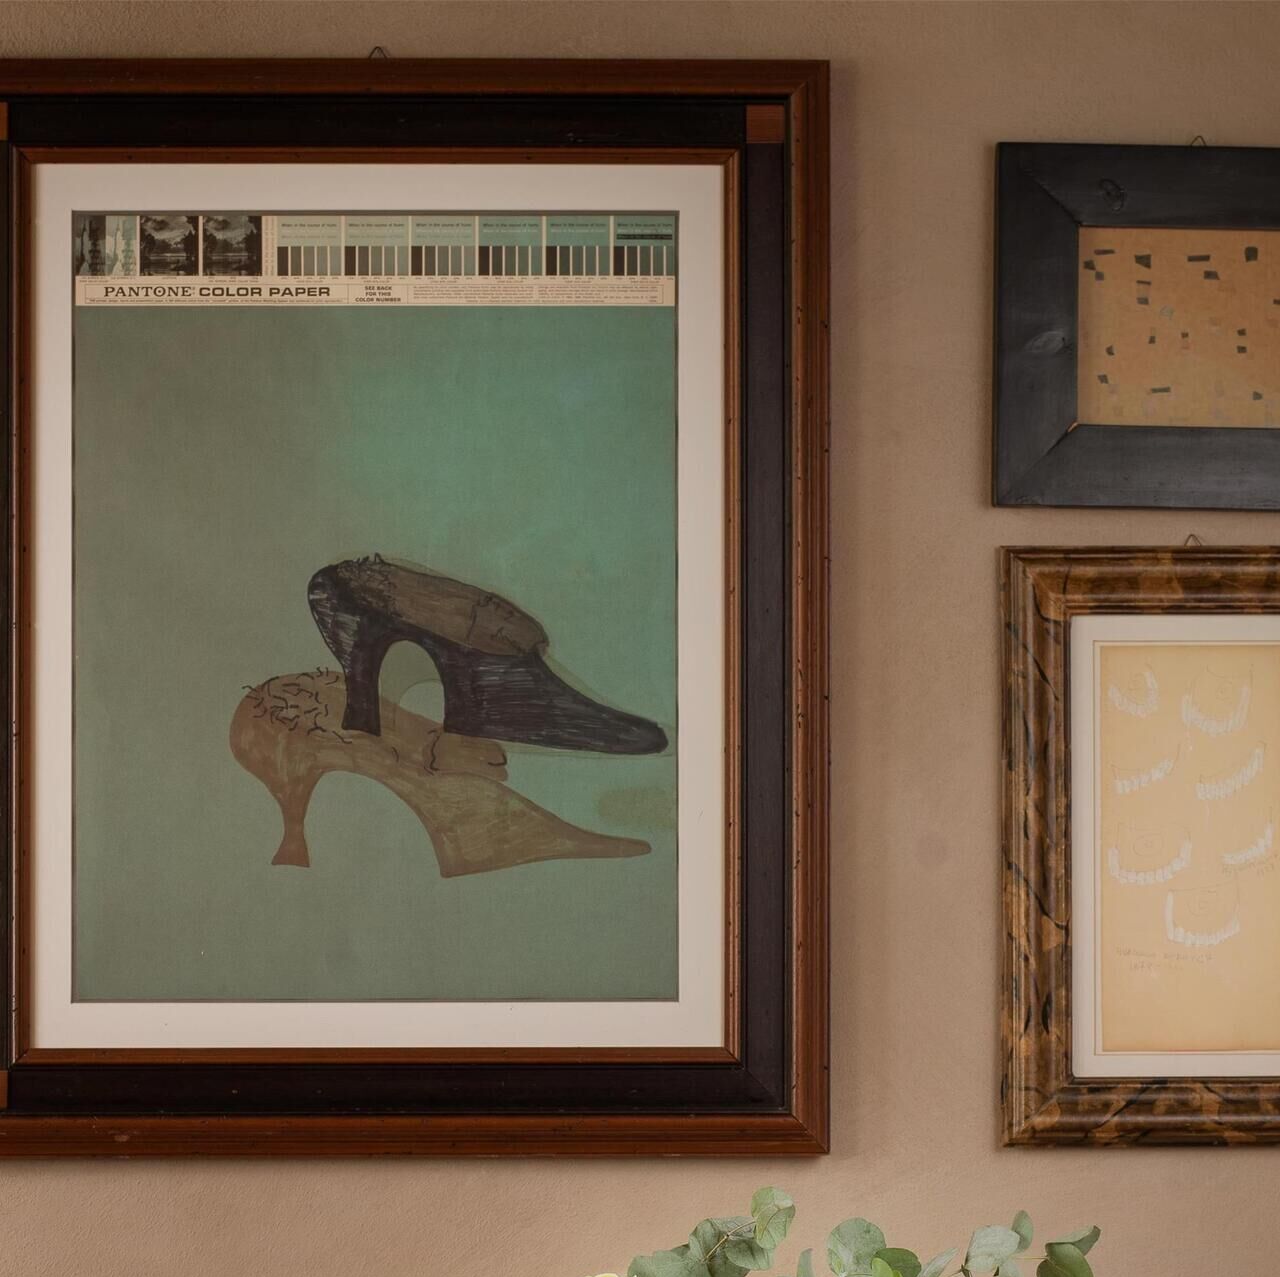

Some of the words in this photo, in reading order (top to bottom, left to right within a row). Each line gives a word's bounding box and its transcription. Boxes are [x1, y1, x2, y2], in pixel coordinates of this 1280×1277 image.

[104, 286, 192, 297] PANTONE
[199, 286, 262, 297] COLOR
[269, 286, 330, 297] PAPER
